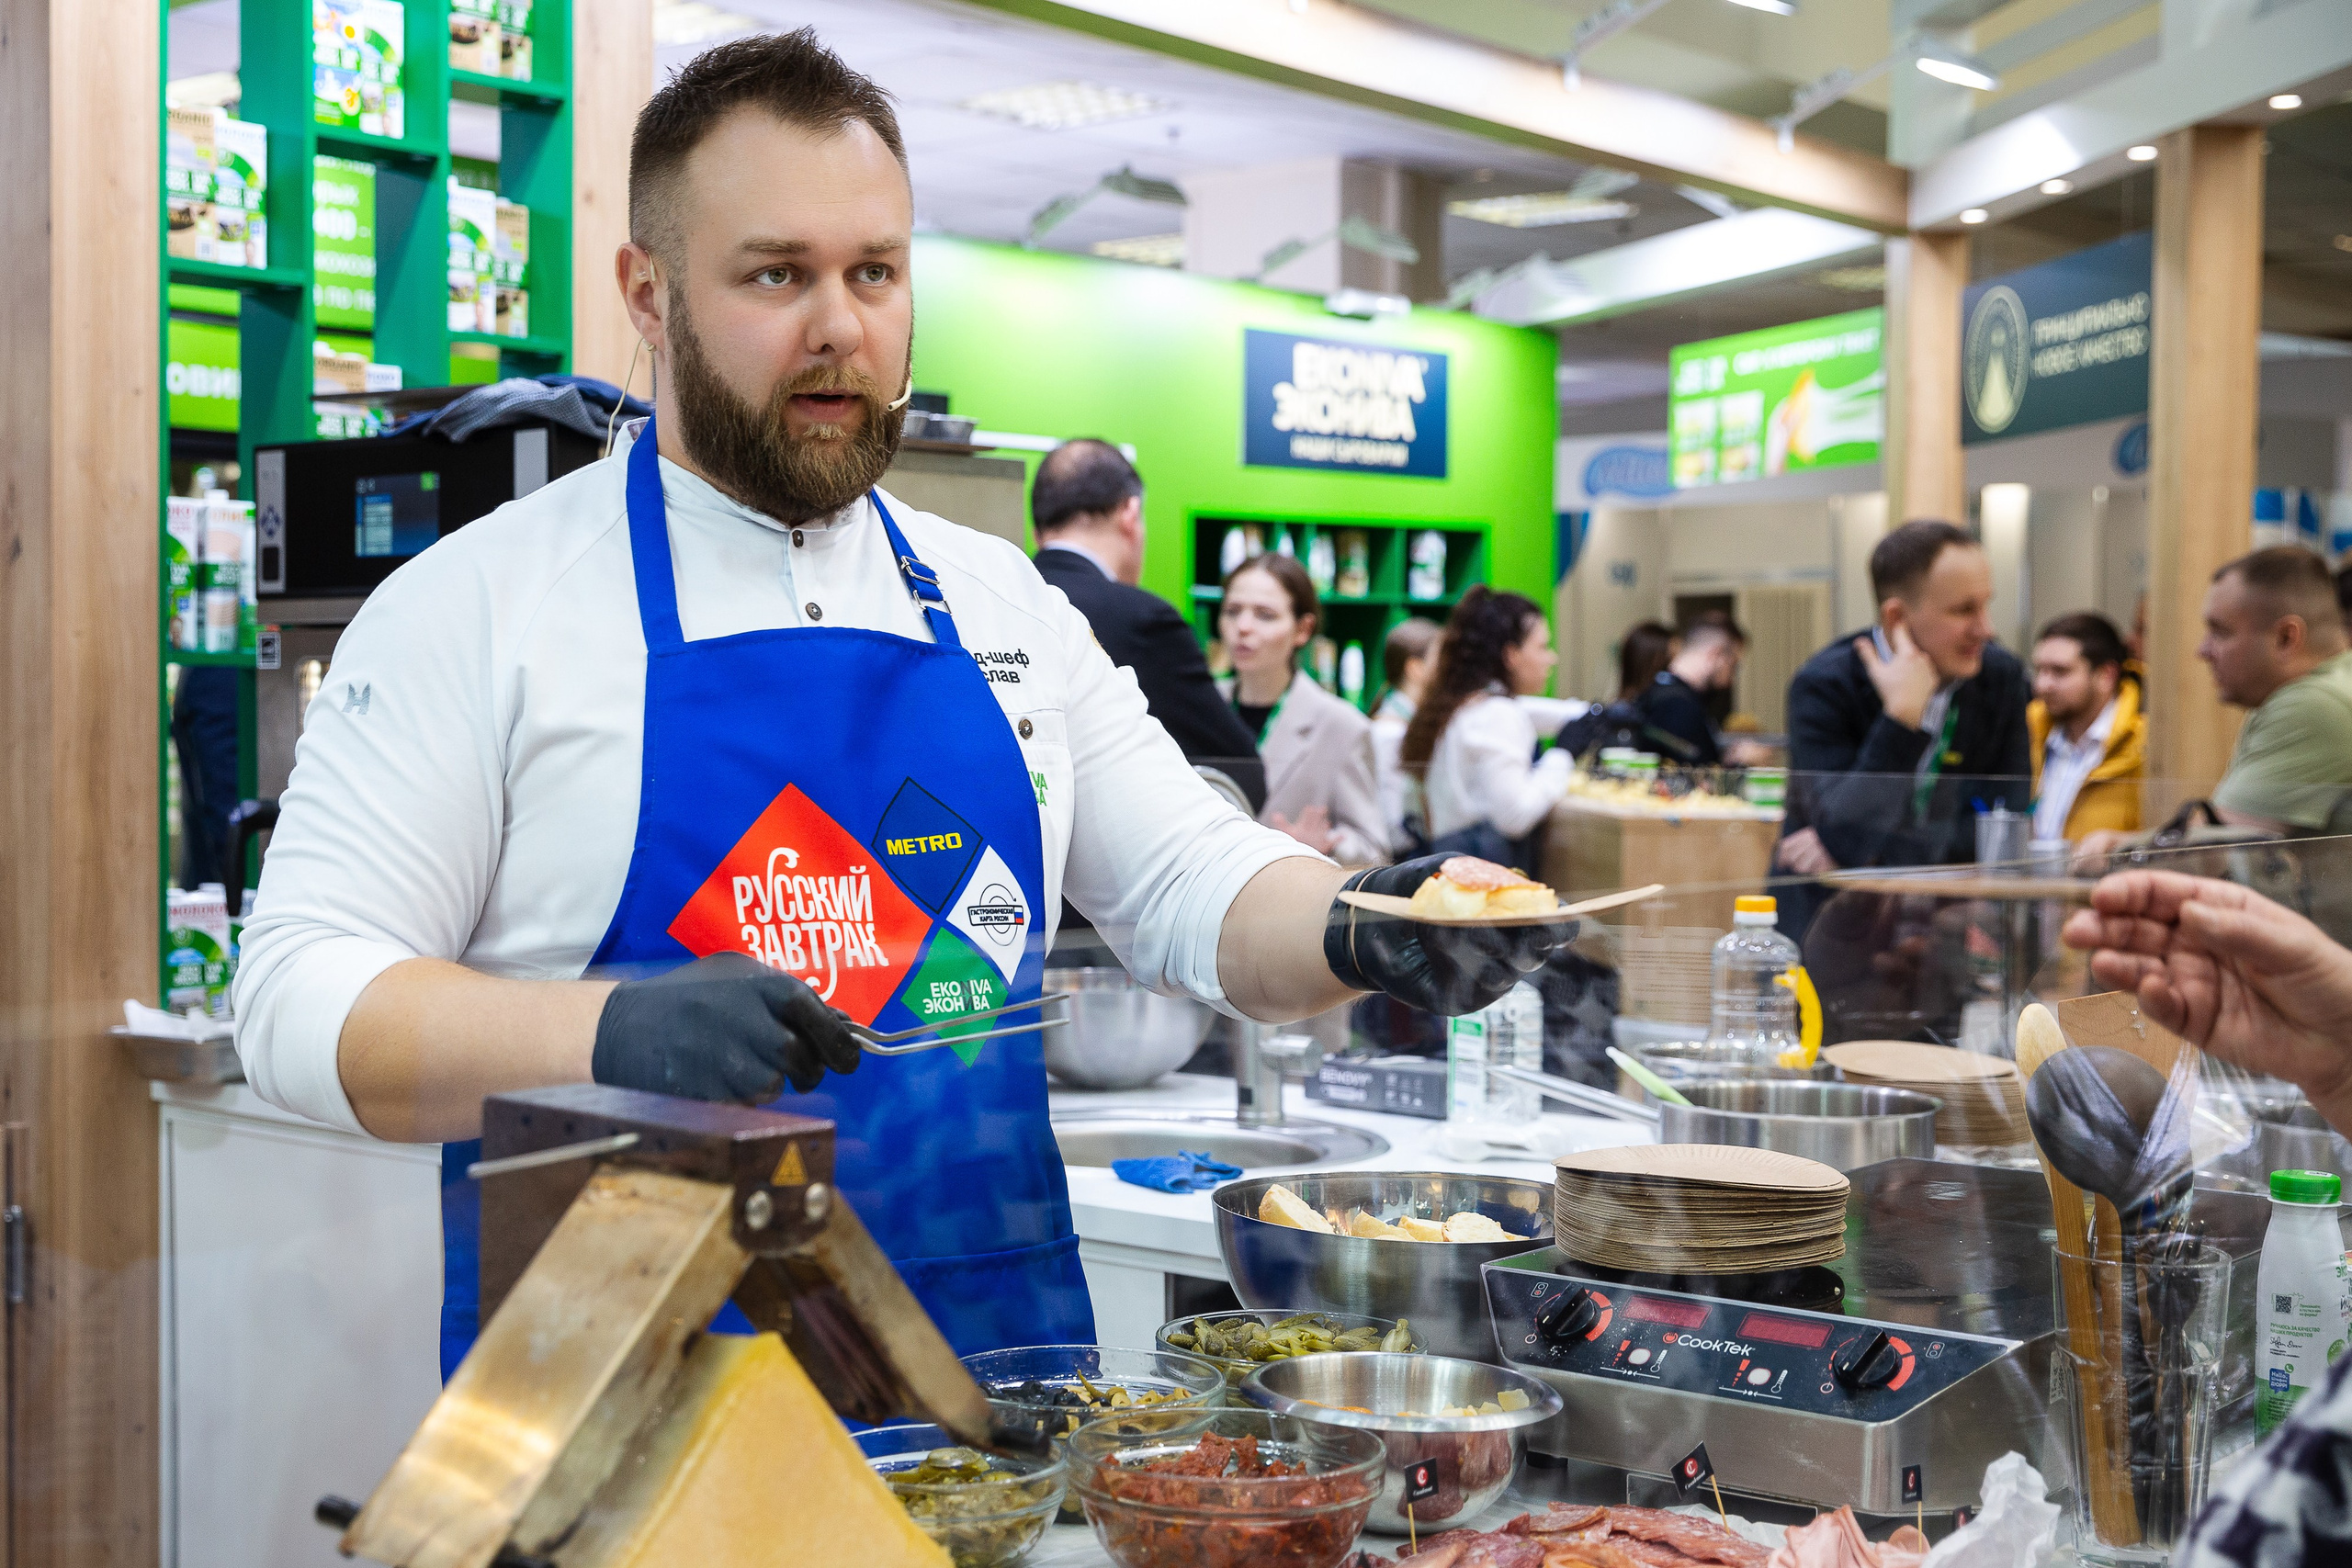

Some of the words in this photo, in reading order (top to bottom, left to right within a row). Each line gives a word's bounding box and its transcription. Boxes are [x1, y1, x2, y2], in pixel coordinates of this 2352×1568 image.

[886, 832, 963, 855] METRO
[732, 847, 873, 923] РУССКИЙ
[970, 908, 1013, 916] ГАСТРОНОМИЧЕСКАЯ
[741, 920, 889, 1002] ЗАВТРАК
[930, 979, 992, 998] EKONIVA
[922, 995, 990, 1014] ЭКОНИВА
[1677, 1334, 1753, 1357] CookTek
